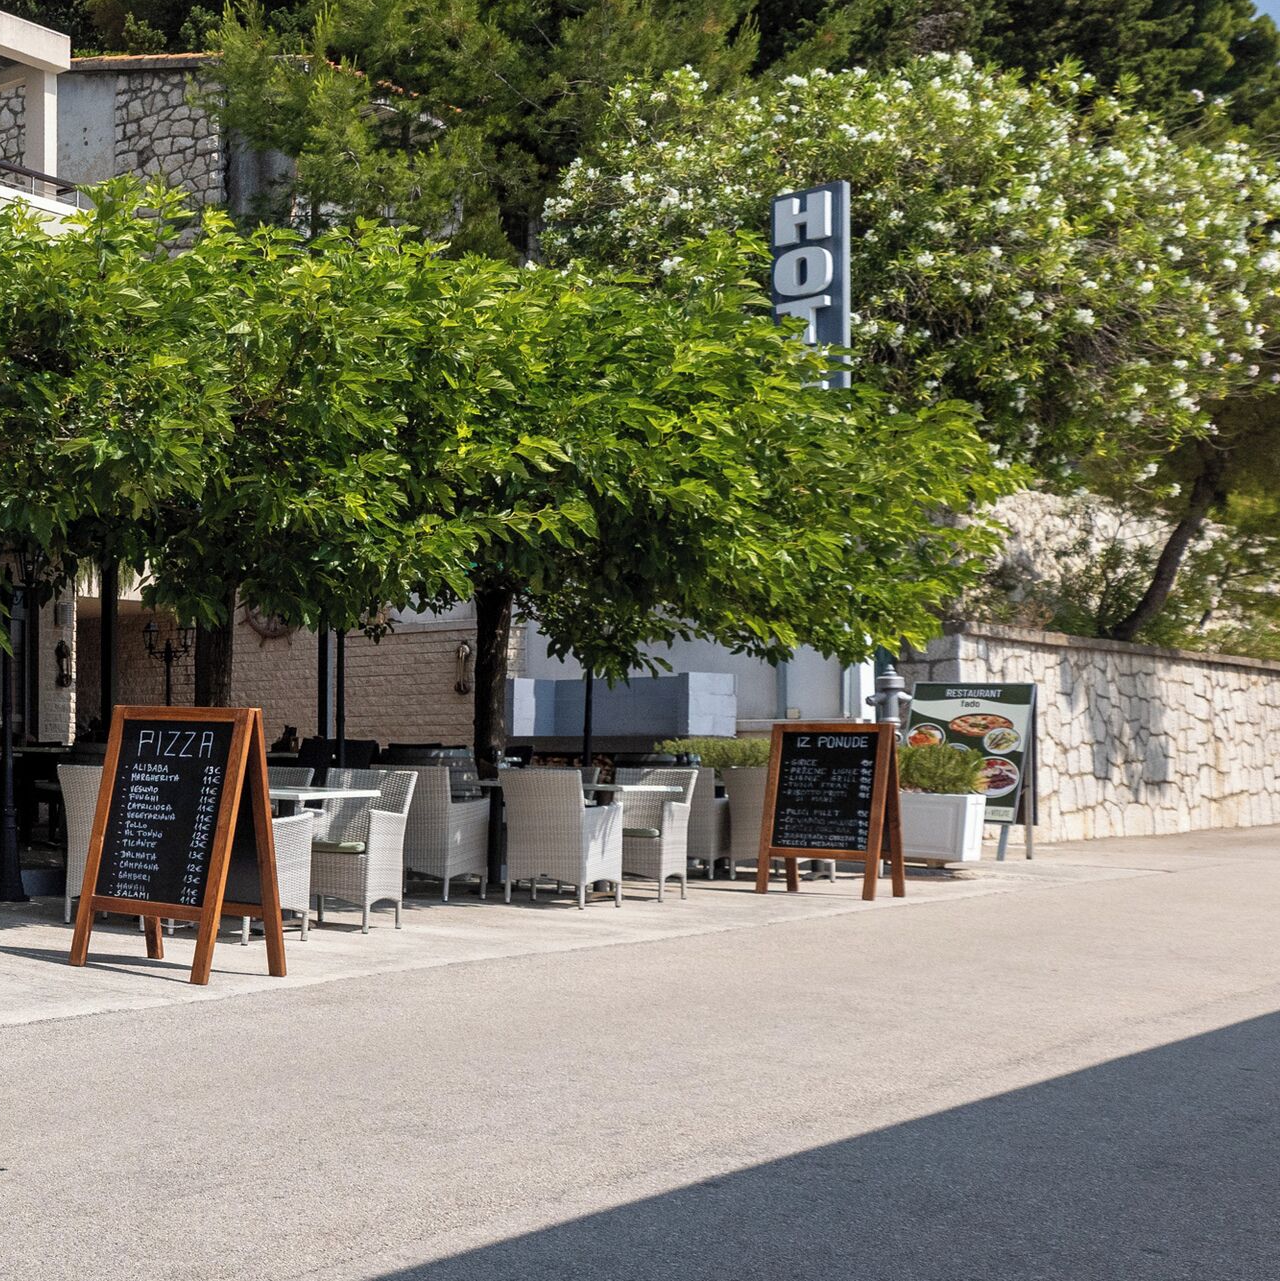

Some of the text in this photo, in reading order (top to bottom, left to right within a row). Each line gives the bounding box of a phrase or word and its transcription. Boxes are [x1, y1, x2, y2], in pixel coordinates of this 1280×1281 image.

[774, 190, 833, 389] HOT
[945, 688, 1002, 698] RESTAURANT
[961, 700, 981, 708] fado
[137, 730, 214, 758] PIZZA
[797, 736, 869, 748] IZ PONUDE
[132, 763, 169, 773] ALIBABA
[131, 773, 221, 784] MARGHERITA 11€
[130, 785, 218, 795] VESUVIO 11€
[129, 793, 216, 804] FUNGHI 11€
[195, 814, 213, 823] 11€
[125, 820, 211, 831] POLLO 11€
[137, 829, 163, 839] TONNO
[192, 831, 209, 840] 12€
[120, 850, 157, 860] DALMATA
[119, 860, 160, 872] CAMPAGNA
[118, 871, 201, 884] GAMBERI 13€
[114, 890, 197, 905] SALAMI 11€
